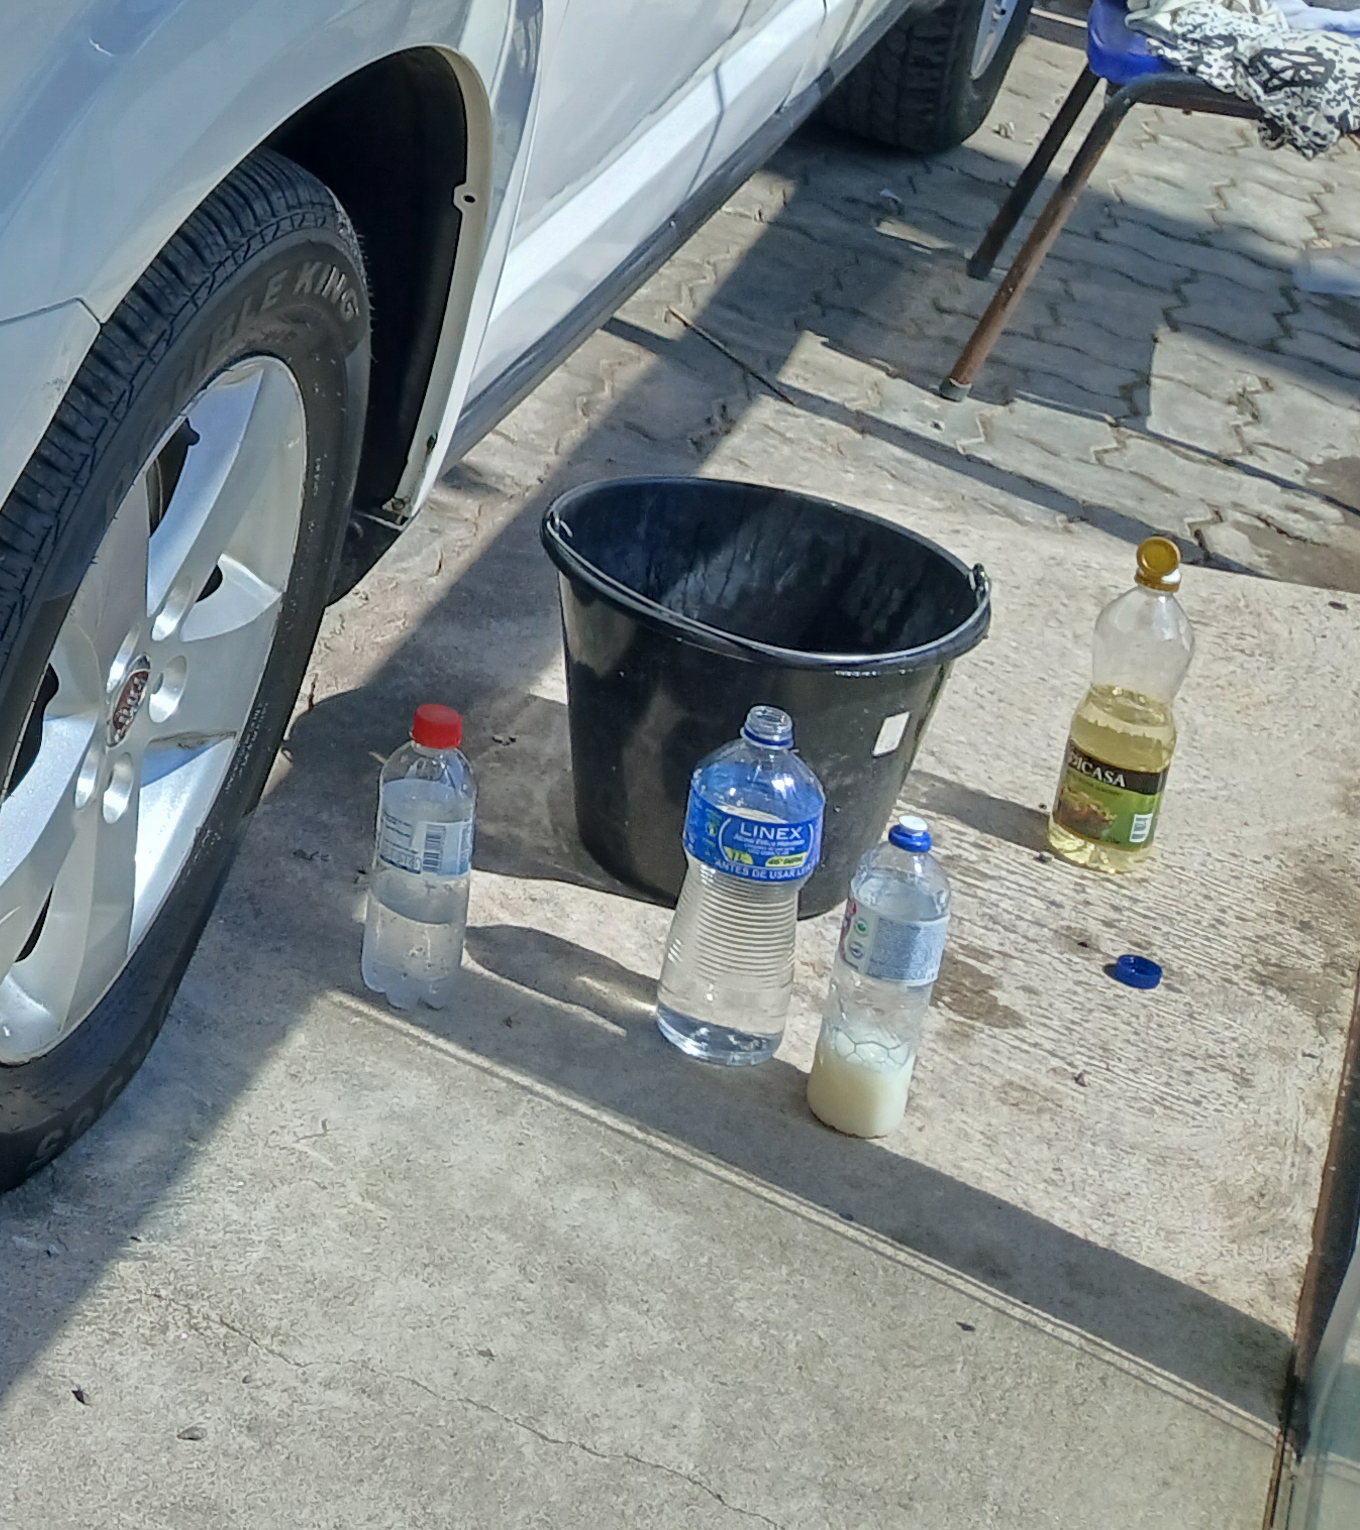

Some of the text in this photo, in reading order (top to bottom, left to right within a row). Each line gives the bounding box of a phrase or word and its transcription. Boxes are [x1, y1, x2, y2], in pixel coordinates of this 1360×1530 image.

[292, 261, 361, 322] KING
[739, 822, 804, 841] LINEX
[714, 859, 749, 877] ANTES
[751, 868, 768, 880] DE
[769, 867, 796, 880] USAR
